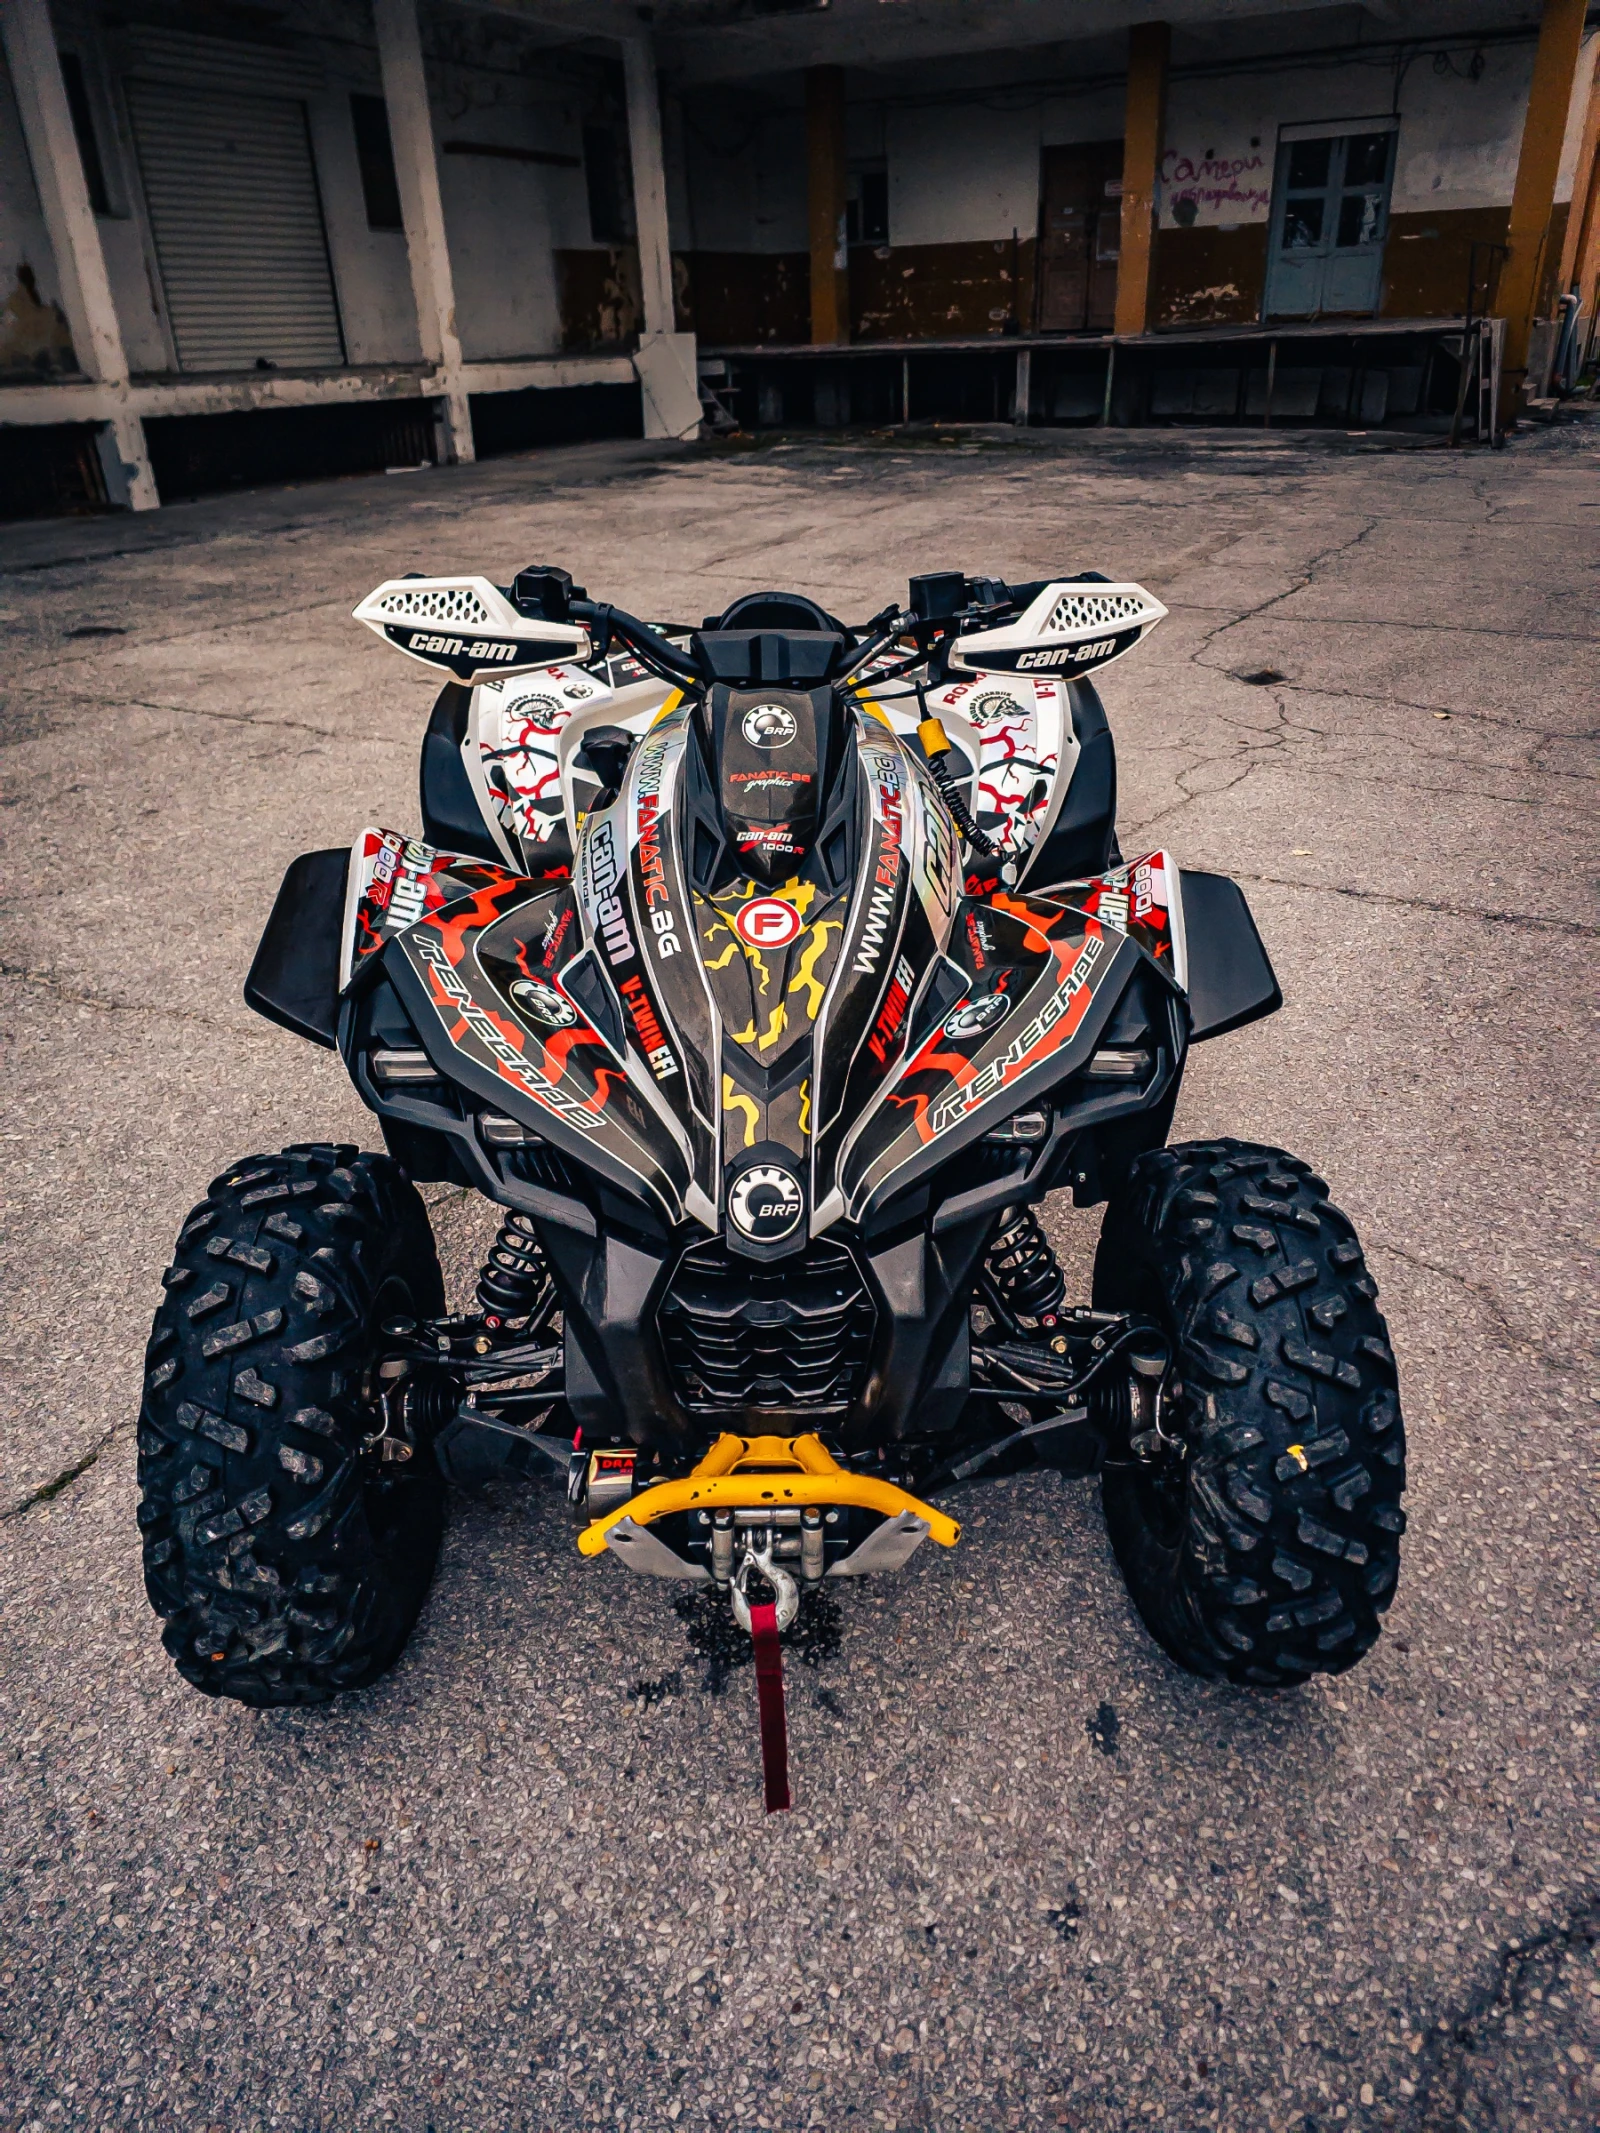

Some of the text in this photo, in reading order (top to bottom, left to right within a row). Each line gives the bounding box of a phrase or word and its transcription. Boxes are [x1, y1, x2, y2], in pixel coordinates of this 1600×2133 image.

[409, 633, 518, 661] can-am
[1015, 638, 1116, 670] can-am
[1033, 680, 1056, 699] V-T
[763, 726, 794, 736] BRP
[729, 769, 812, 784] FANATIC.BG
[736, 831, 793, 843] can-am
[366, 833, 403, 906] 000R
[385, 840, 437, 929] an-am
[588, 820, 636, 965] can-am
[1135, 863, 1153, 918] 1000
[754, 913, 785, 935] F
[531, 997, 560, 1024] BRP
[976, 996, 1002, 1021] BRP
[412, 934, 607, 1129] RENEGADE
[931, 936, 1105, 1133] RENEGADE
[759, 1203, 799, 1217] BRP
